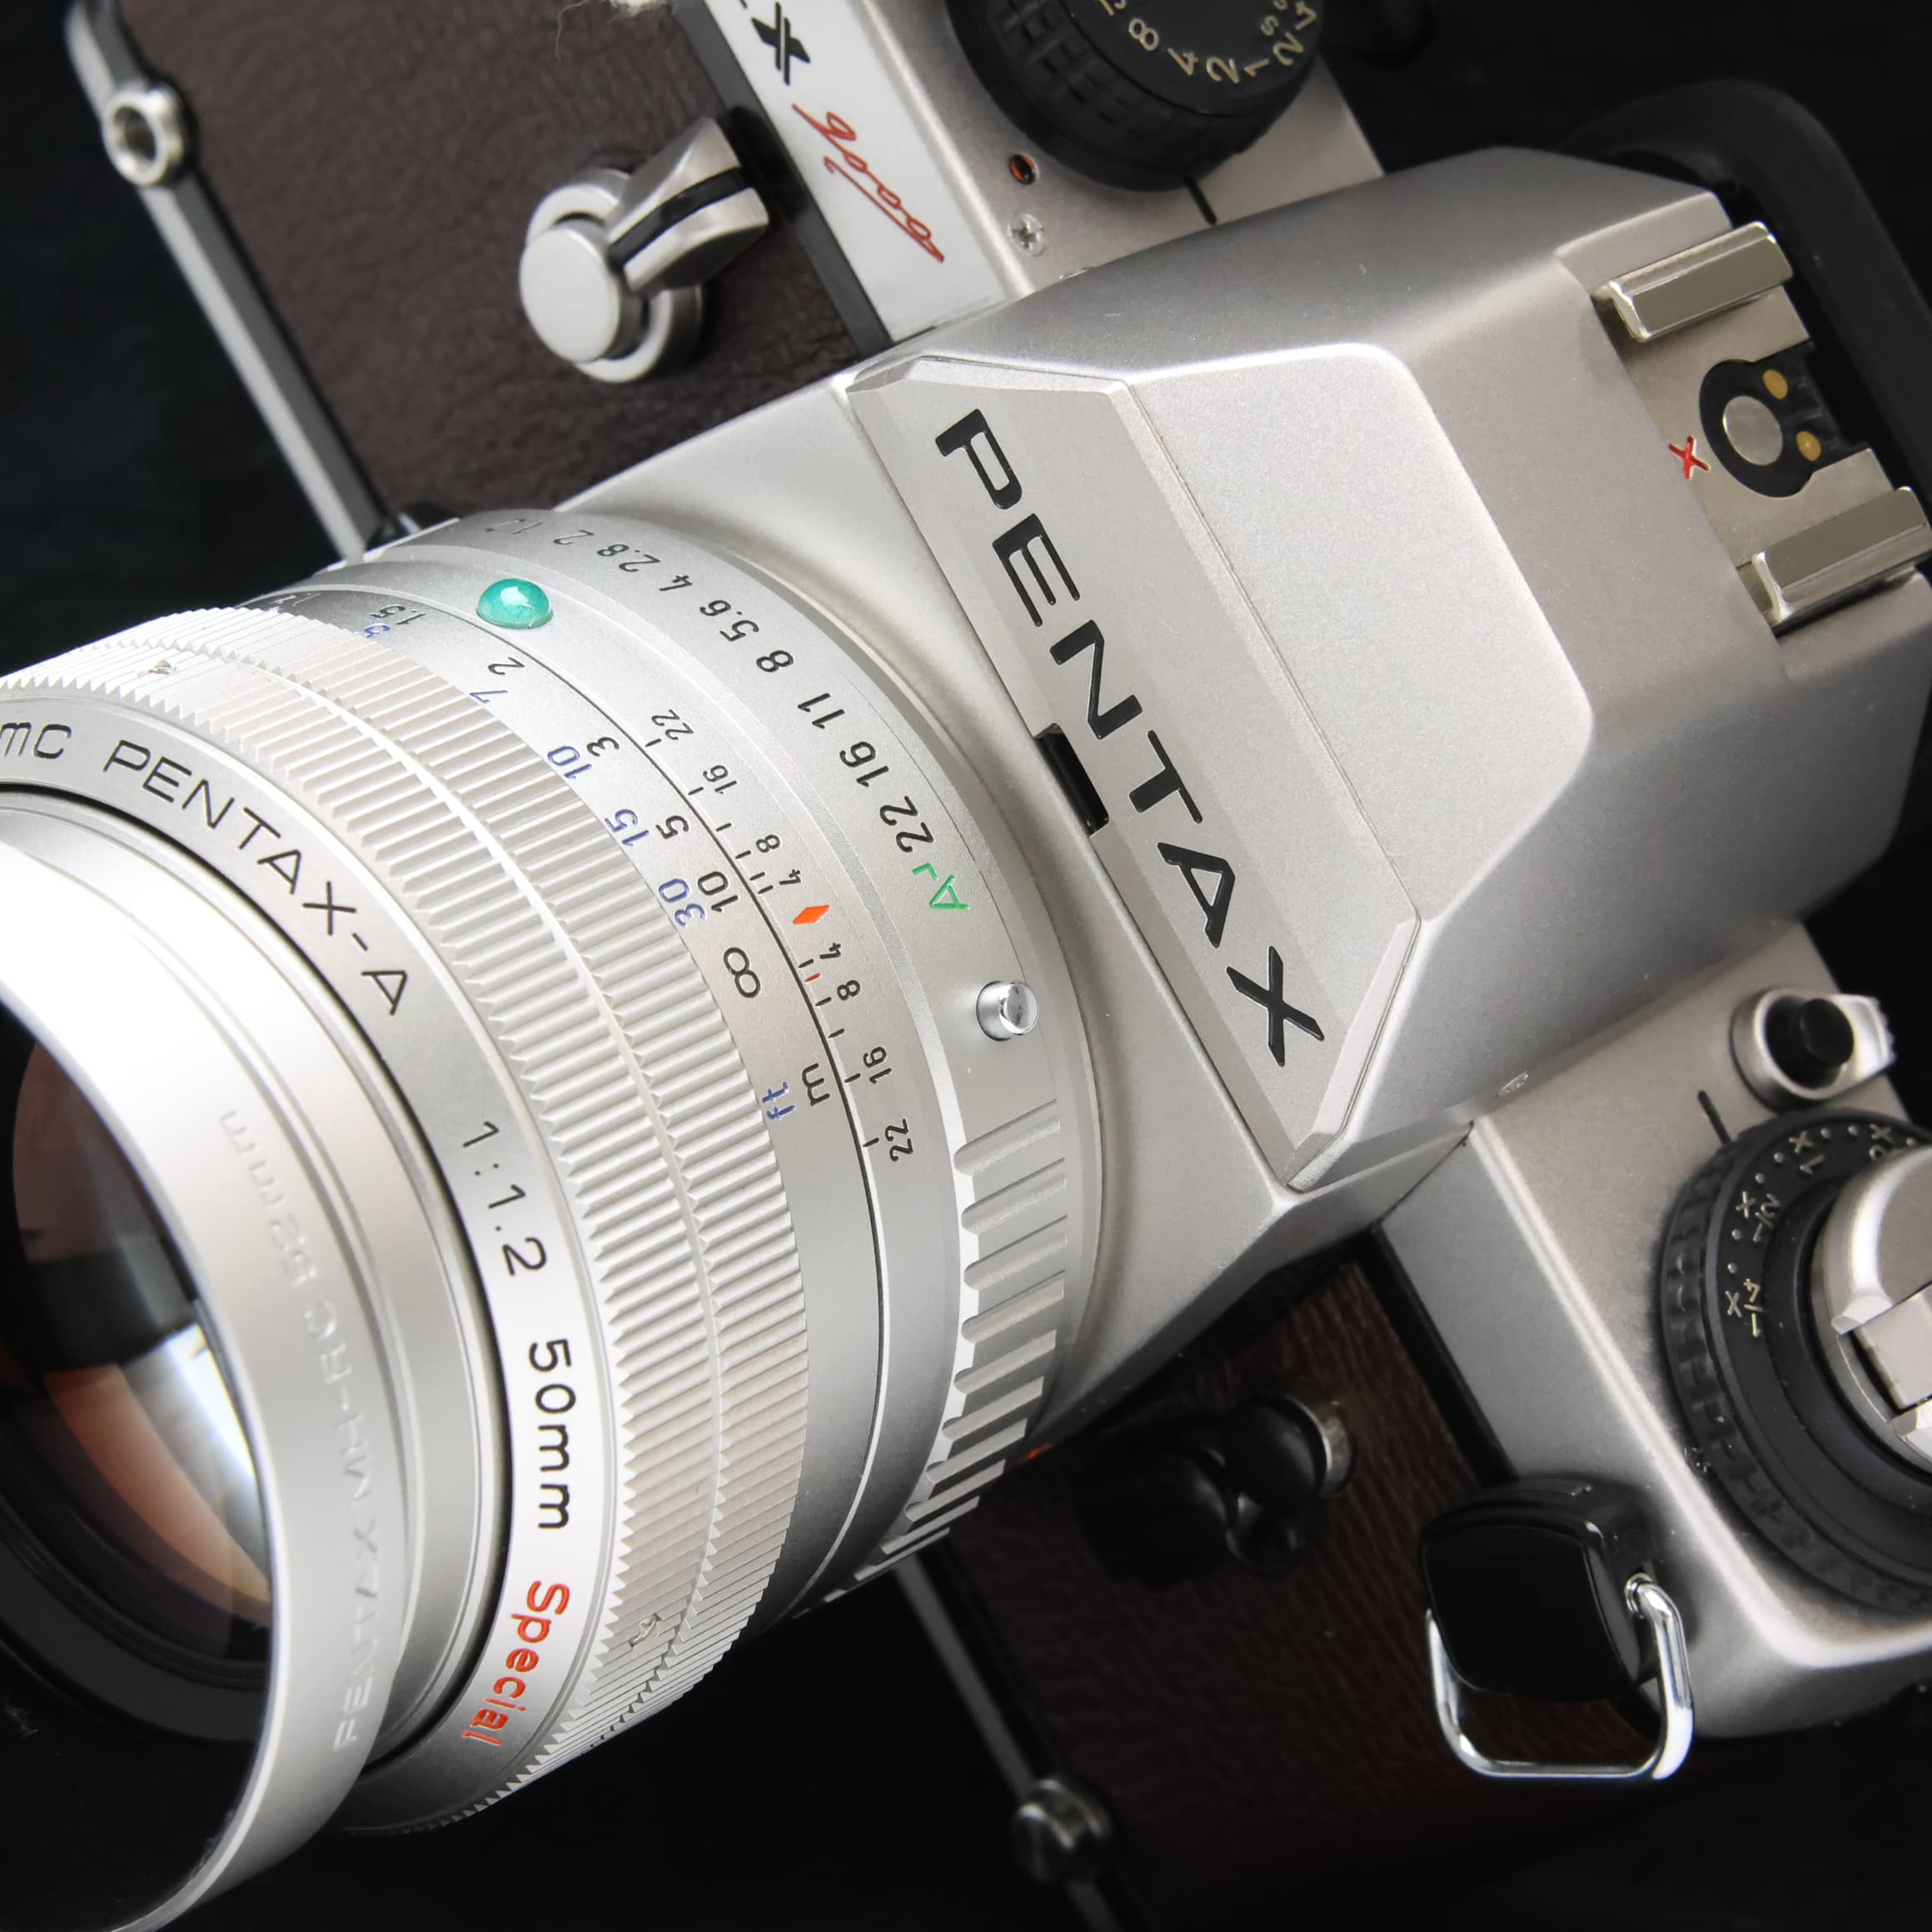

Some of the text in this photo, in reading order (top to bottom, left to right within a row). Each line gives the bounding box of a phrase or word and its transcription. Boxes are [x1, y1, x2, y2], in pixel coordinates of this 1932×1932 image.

[739, 0, 811, 87] X
[1128, 17, 1159, 51] 8
[1167, 47, 1199, 76] 4
[1206, 57, 1239, 84] 2
[1244, 58, 1269, 77] 1
[553, 530, 595, 545] 2
[597, 544, 660, 572] 2.8
[659, 575, 693, 593] 4
[700, 600, 759, 642] 5.6
[756, 650, 794, 673] 8
[797, 692, 845, 729] 11
[839, 741, 889, 788] 16
[879, 795, 934, 853] 22
[929, 874, 970, 909] A
[934, 408, 1325, 1067] PENTAX
[103, 739, 409, 1016] PENTAX-A
[487, 656, 525, 675] 2
[586, 735, 620, 757] 3
[655, 814, 690, 840] 5
[697, 870, 739, 914] 10
[801, 1063, 831, 1106] m
[547, 745, 593, 780] 10
[604, 808, 650, 848] 15
[659, 878, 707, 927] 30
[762, 1082, 796, 1121] ft
[651, 709, 914, 1162] 22 16 8 4 4 8 16 22
[462, 1120, 548, 1277] 1:1.2
[528, 1337, 577, 1531] 50mm
[332, 1517, 380, 1752] PENTAX
[460, 1579, 571, 1746] Special
